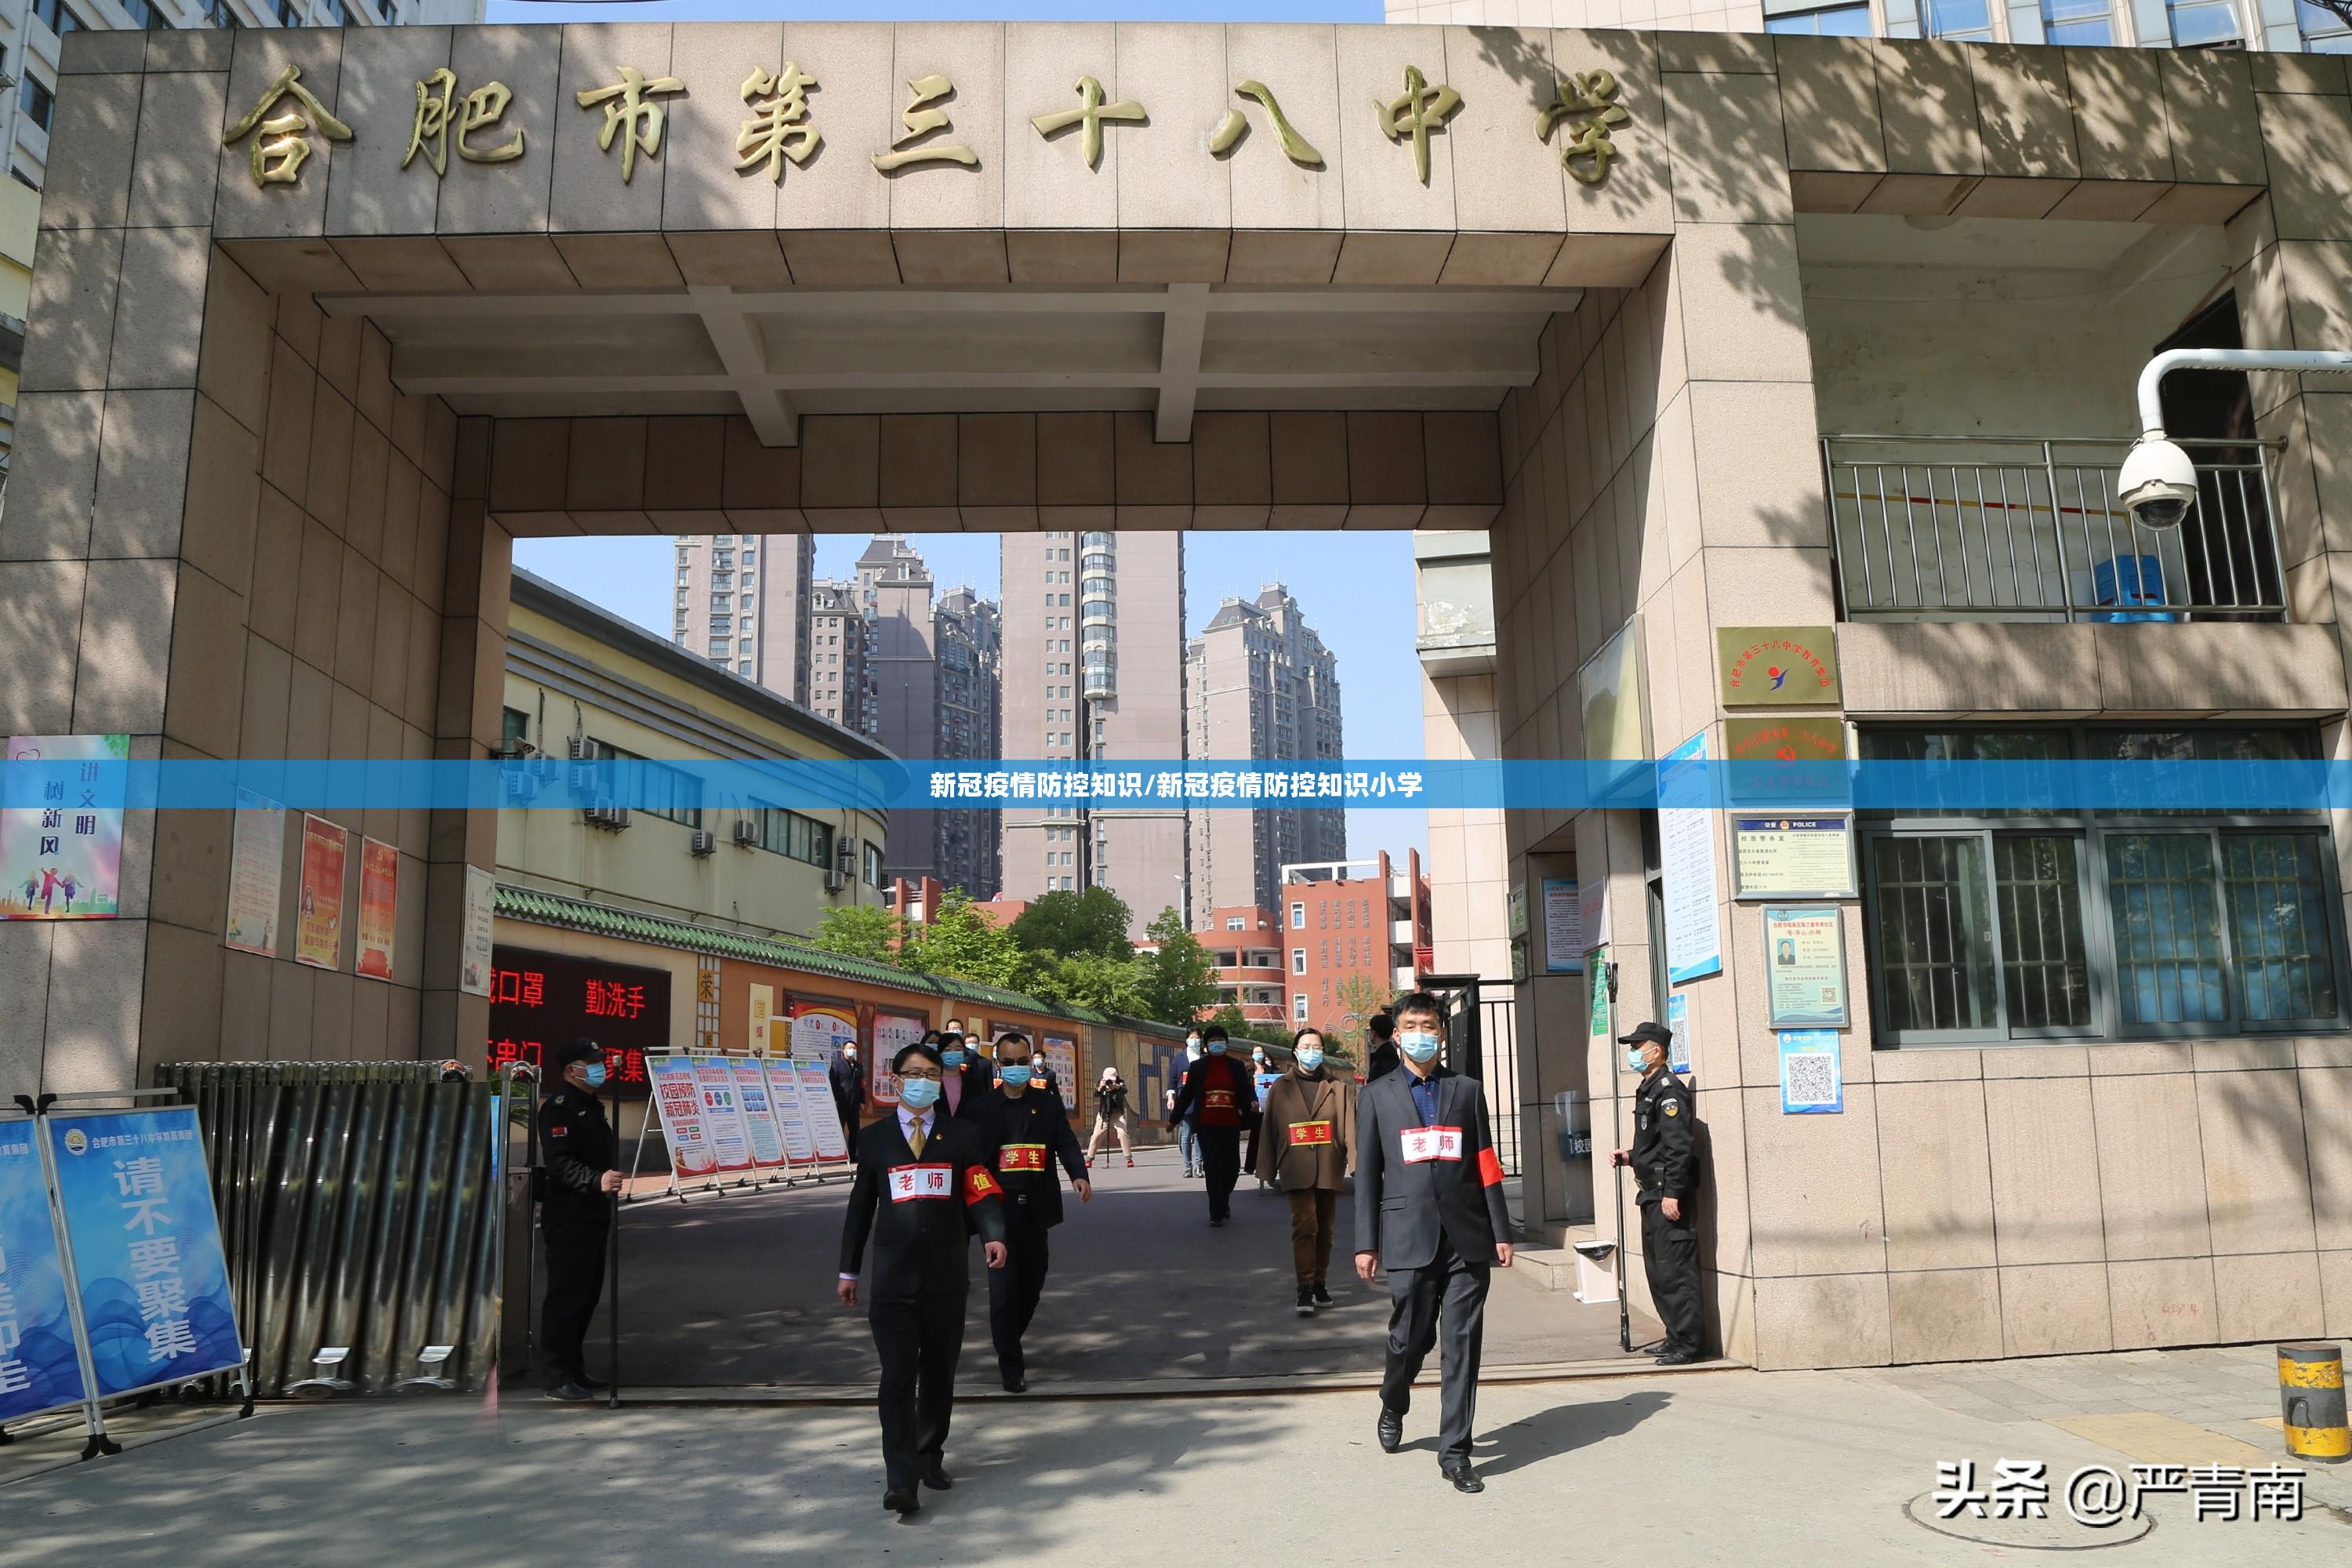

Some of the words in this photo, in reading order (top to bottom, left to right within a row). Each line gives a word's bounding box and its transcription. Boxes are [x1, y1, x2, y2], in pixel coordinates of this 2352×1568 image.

[223, 61, 1628, 187] 合肥市第三十八中学
[1730, 640, 1831, 688] 合肥市第三十八中学教育集团
[75, 761, 100, 837] 讲文明
[38, 780, 64, 856] 树新风
[585, 978, 646, 1021] 勤洗手
[659, 1083, 696, 1101] 校园预防
[663, 1101, 700, 1118] 新冠肺炎
[91, 1129, 193, 1149] 合肥市第三十八中学教育集团
[1296, 1125, 1326, 1141] 学生
[1413, 1136, 1454, 1154] 老师
[1005, 1150, 1040, 1165] 学生
[898, 1171, 944, 1192] 老师
[972, 1171, 993, 1192] 值
[114, 1156, 197, 1363] 请不要聚集
